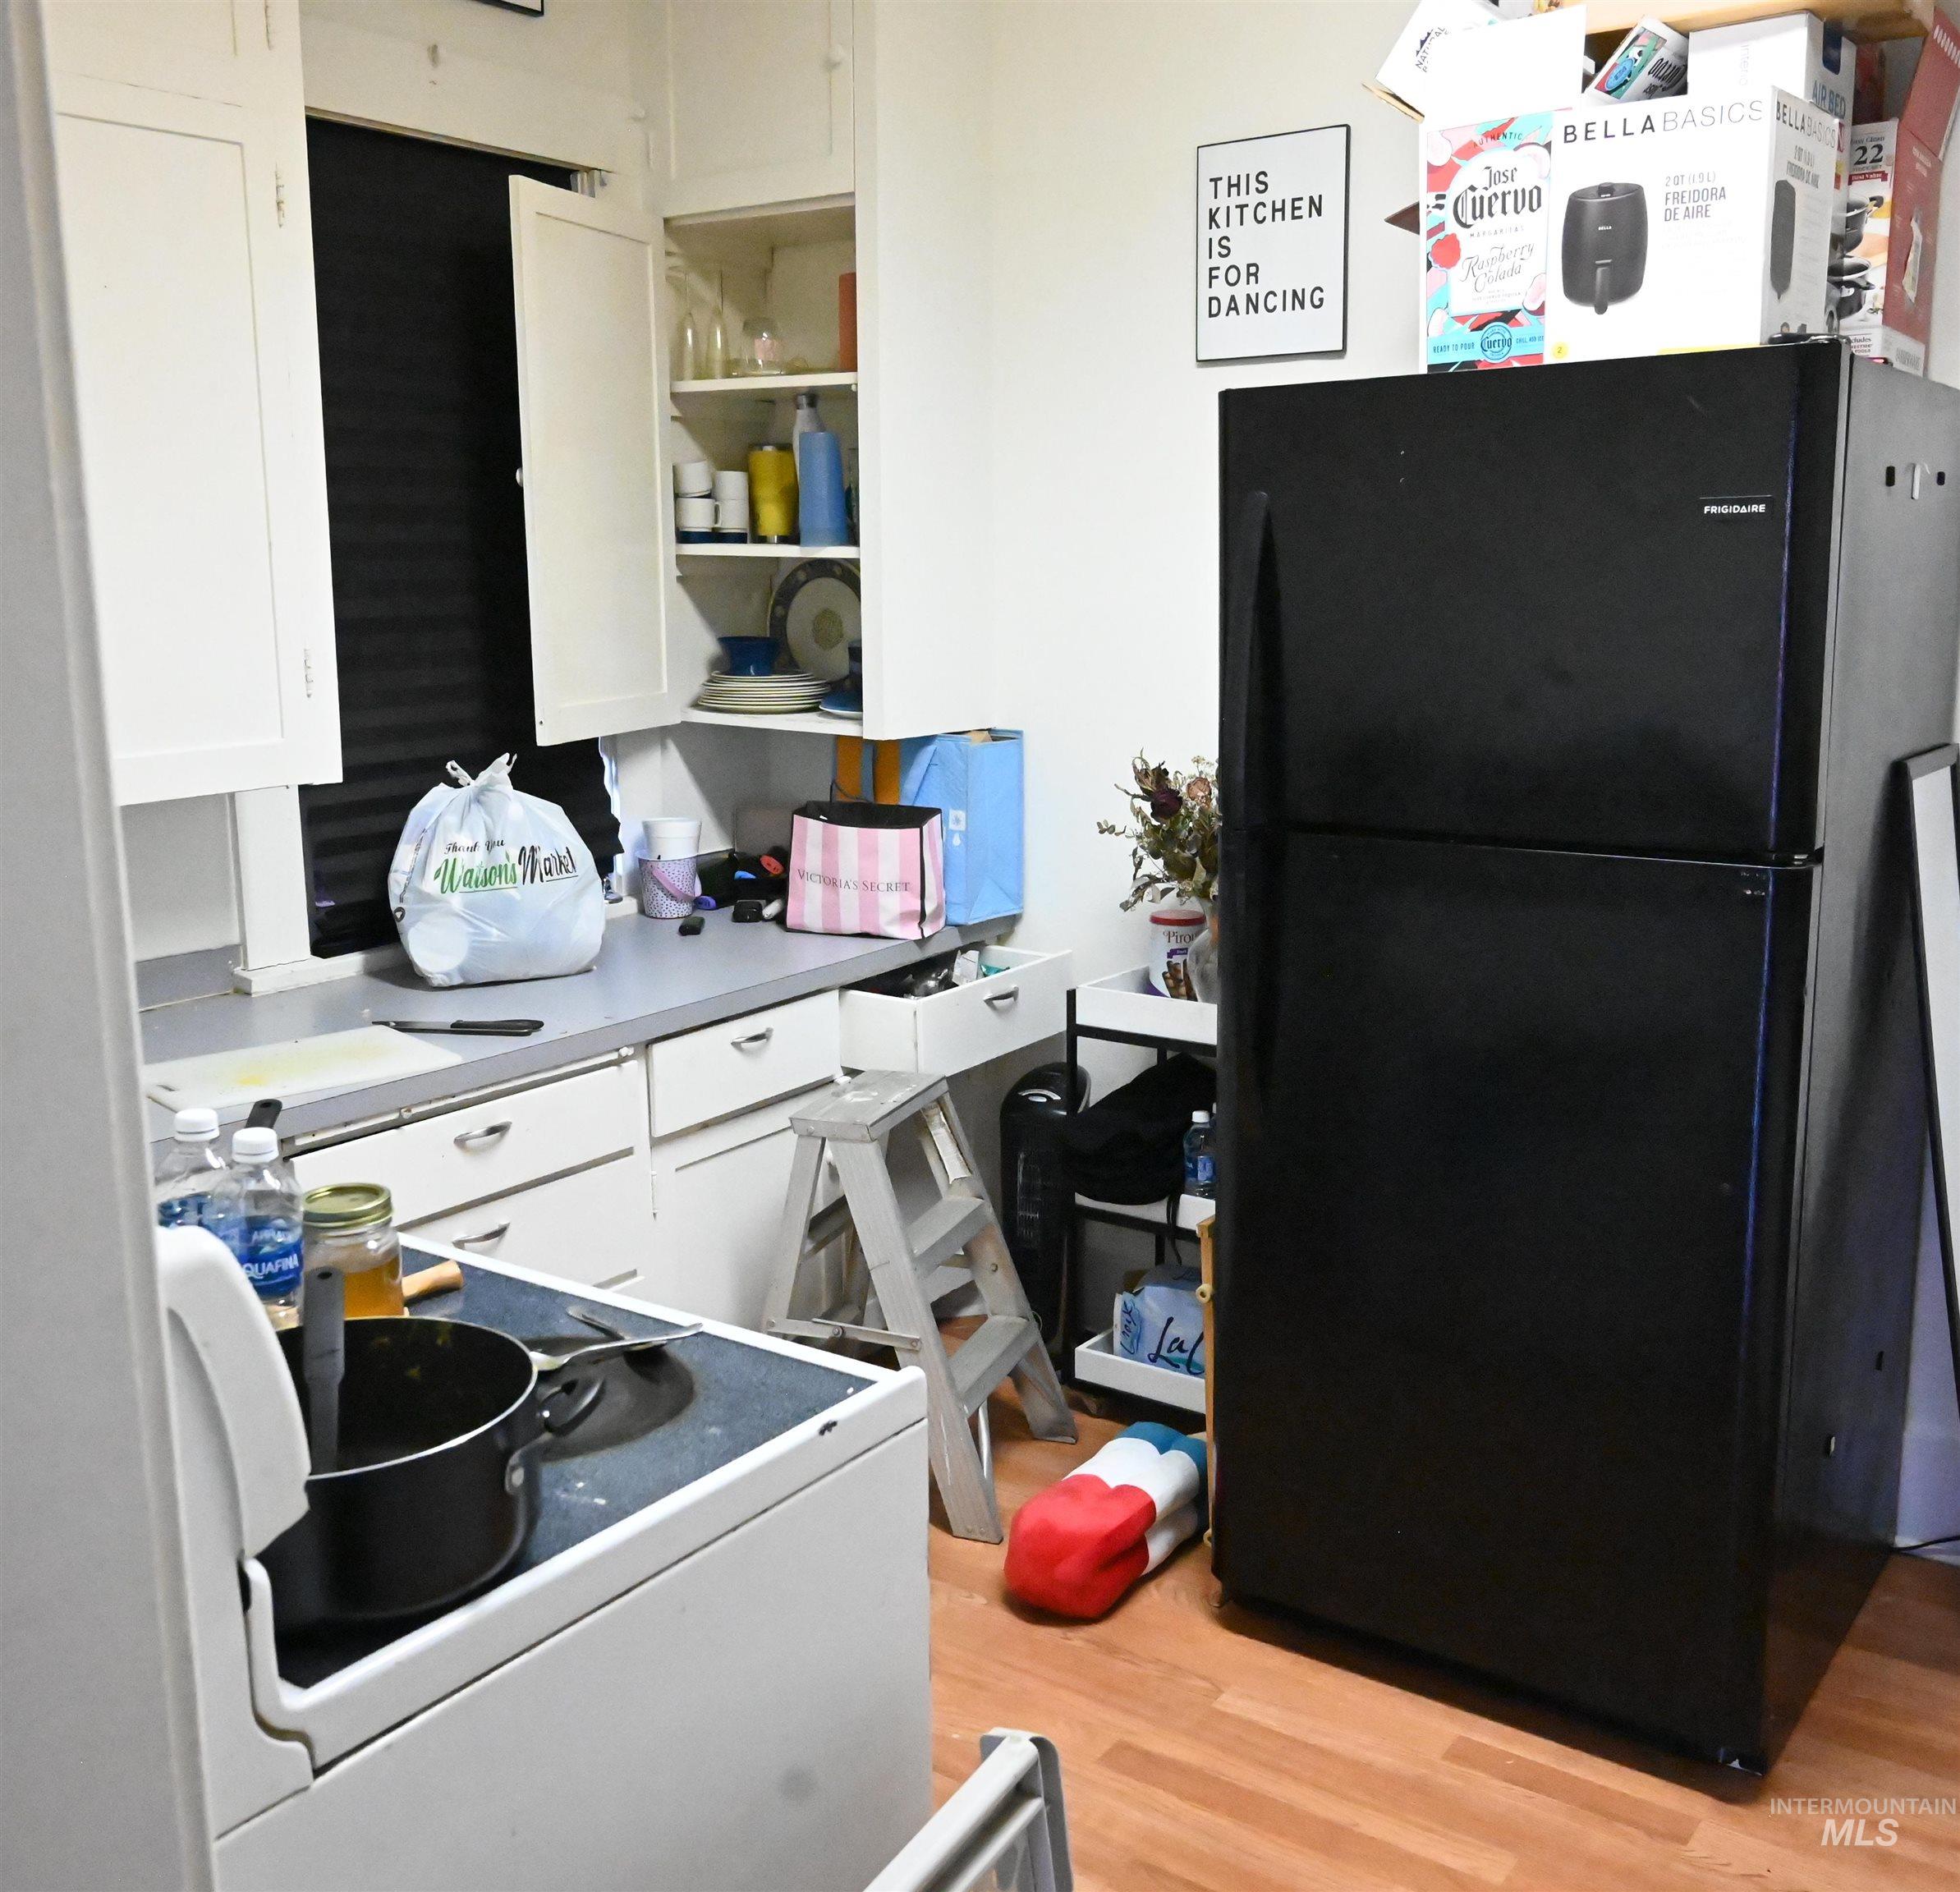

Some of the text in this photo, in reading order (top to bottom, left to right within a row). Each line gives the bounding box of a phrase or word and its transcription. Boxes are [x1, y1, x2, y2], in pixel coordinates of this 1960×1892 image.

[1415, 26, 1446, 69] NATAL
[1812, 81, 1846, 120] AIR BED
[1563, 100, 1763, 144] BELLA BASICS
[1776, 99, 1805, 134] BELLA
[1806, 116, 1836, 149] BASICS
[1473, 131, 1523, 149] AUTHENTIC
[1853, 144, 1884, 165] 22
[1209, 171, 1269, 200] THIS
[1665, 177, 1671, 187] 2
[1673, 174, 1685, 186] QT
[1453, 184, 1542, 229] Cuervo
[1664, 186, 1727, 206] FREIDORA
[1209, 194, 1323, 230] KITCHEN
[1664, 204, 1711, 222] DE AIRE
[1470, 226, 1524, 237] MARGARITAS
[1209, 235, 1232, 259] IS
[1209, 263, 1260, 289] FOR
[1460, 244, 1535, 282] Raspberry
[1474, 261, 1522, 292] Colada
[1209, 286, 1324, 319] DANCING
[1433, 342, 1475, 353] READY TO POUR
[1480, 336, 1512, 352] Cuervo
[1704, 504, 1766, 514] FRIGIDAIRE
[518, 845, 577, 885] Market
[797, 869, 911, 893] VICTORIA'S SECRET
[243, 1253, 299, 1279] QUAFINA
